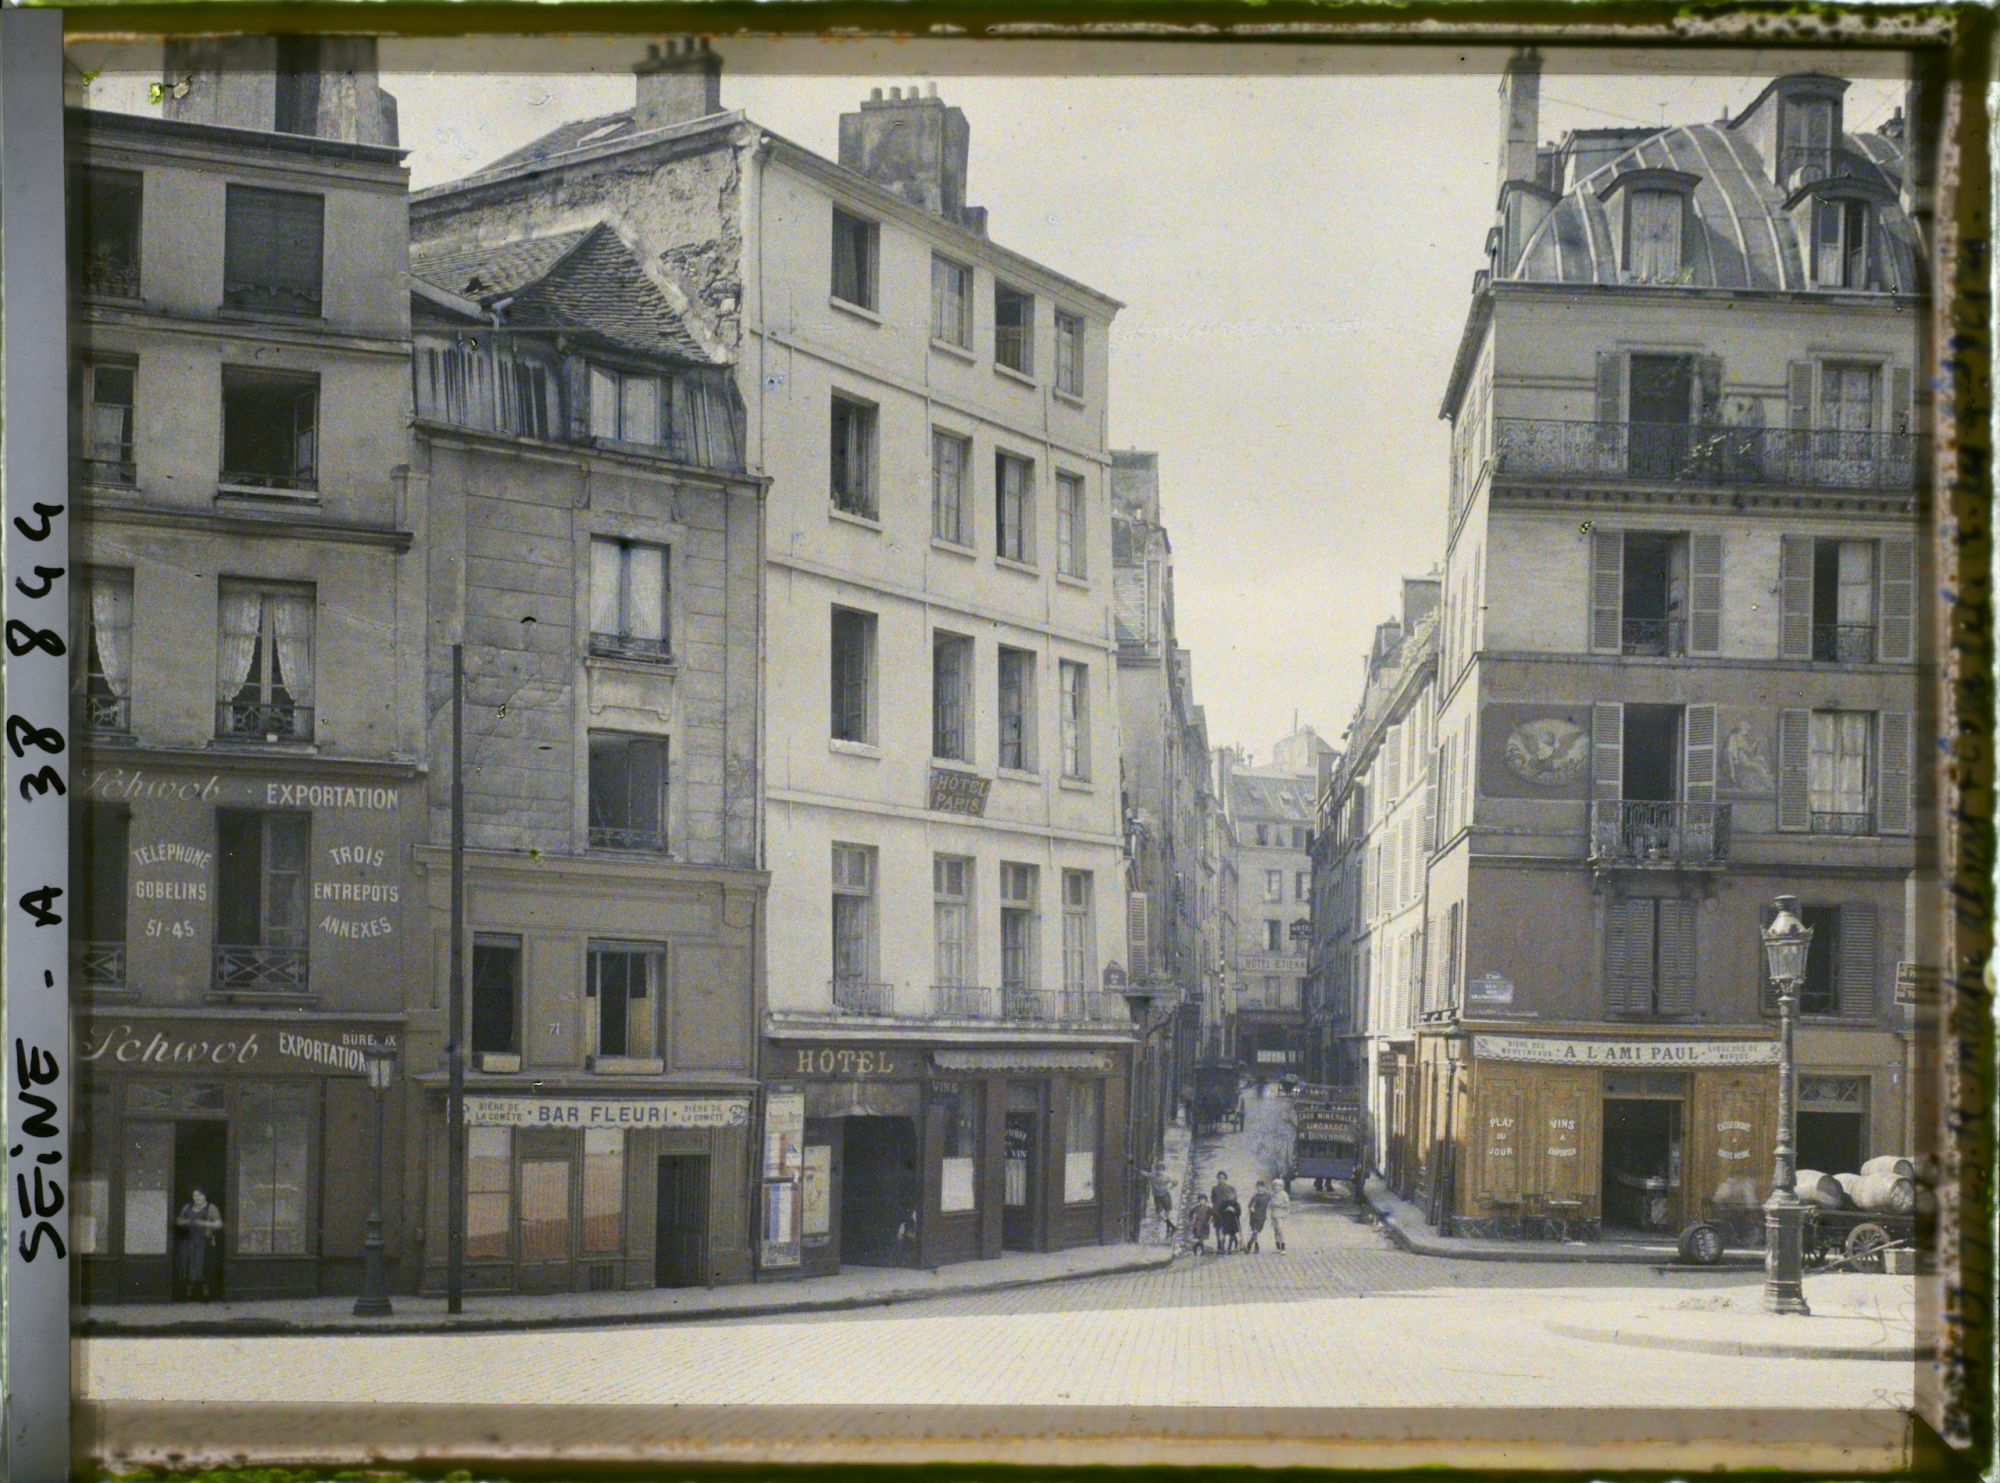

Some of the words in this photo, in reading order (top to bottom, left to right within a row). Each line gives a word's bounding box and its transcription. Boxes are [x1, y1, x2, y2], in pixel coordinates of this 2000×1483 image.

[267, 783, 399, 810] EXPORTATION
[329, 846, 384, 867] TROIS
[136, 880, 206, 901] GOBELINS
[19, 884, 63, 927] A
[145, 918, 194, 939] 51-45
[318, 915, 392, 939] ANNEXES
[81, 1024, 259, 1064] Schwob
[342, 1033, 396, 1047] BUREX
[279, 1031, 366, 1073] EXPORTATION
[1565, 1045, 1576, 1058] A
[1651, 1047, 1699, 1061] PAUL
[932, 1081, 959, 1094] VINS
[508, 1103, 519, 1112] DE
[539, 1106, 579, 1122] BAR
[591, 1106, 669, 1123] FLEURI
[1489, 1118, 1514, 1128] PLAT
[1550, 1118, 1576, 1130] VINS
[1488, 1147, 1513, 1156] JOUR
